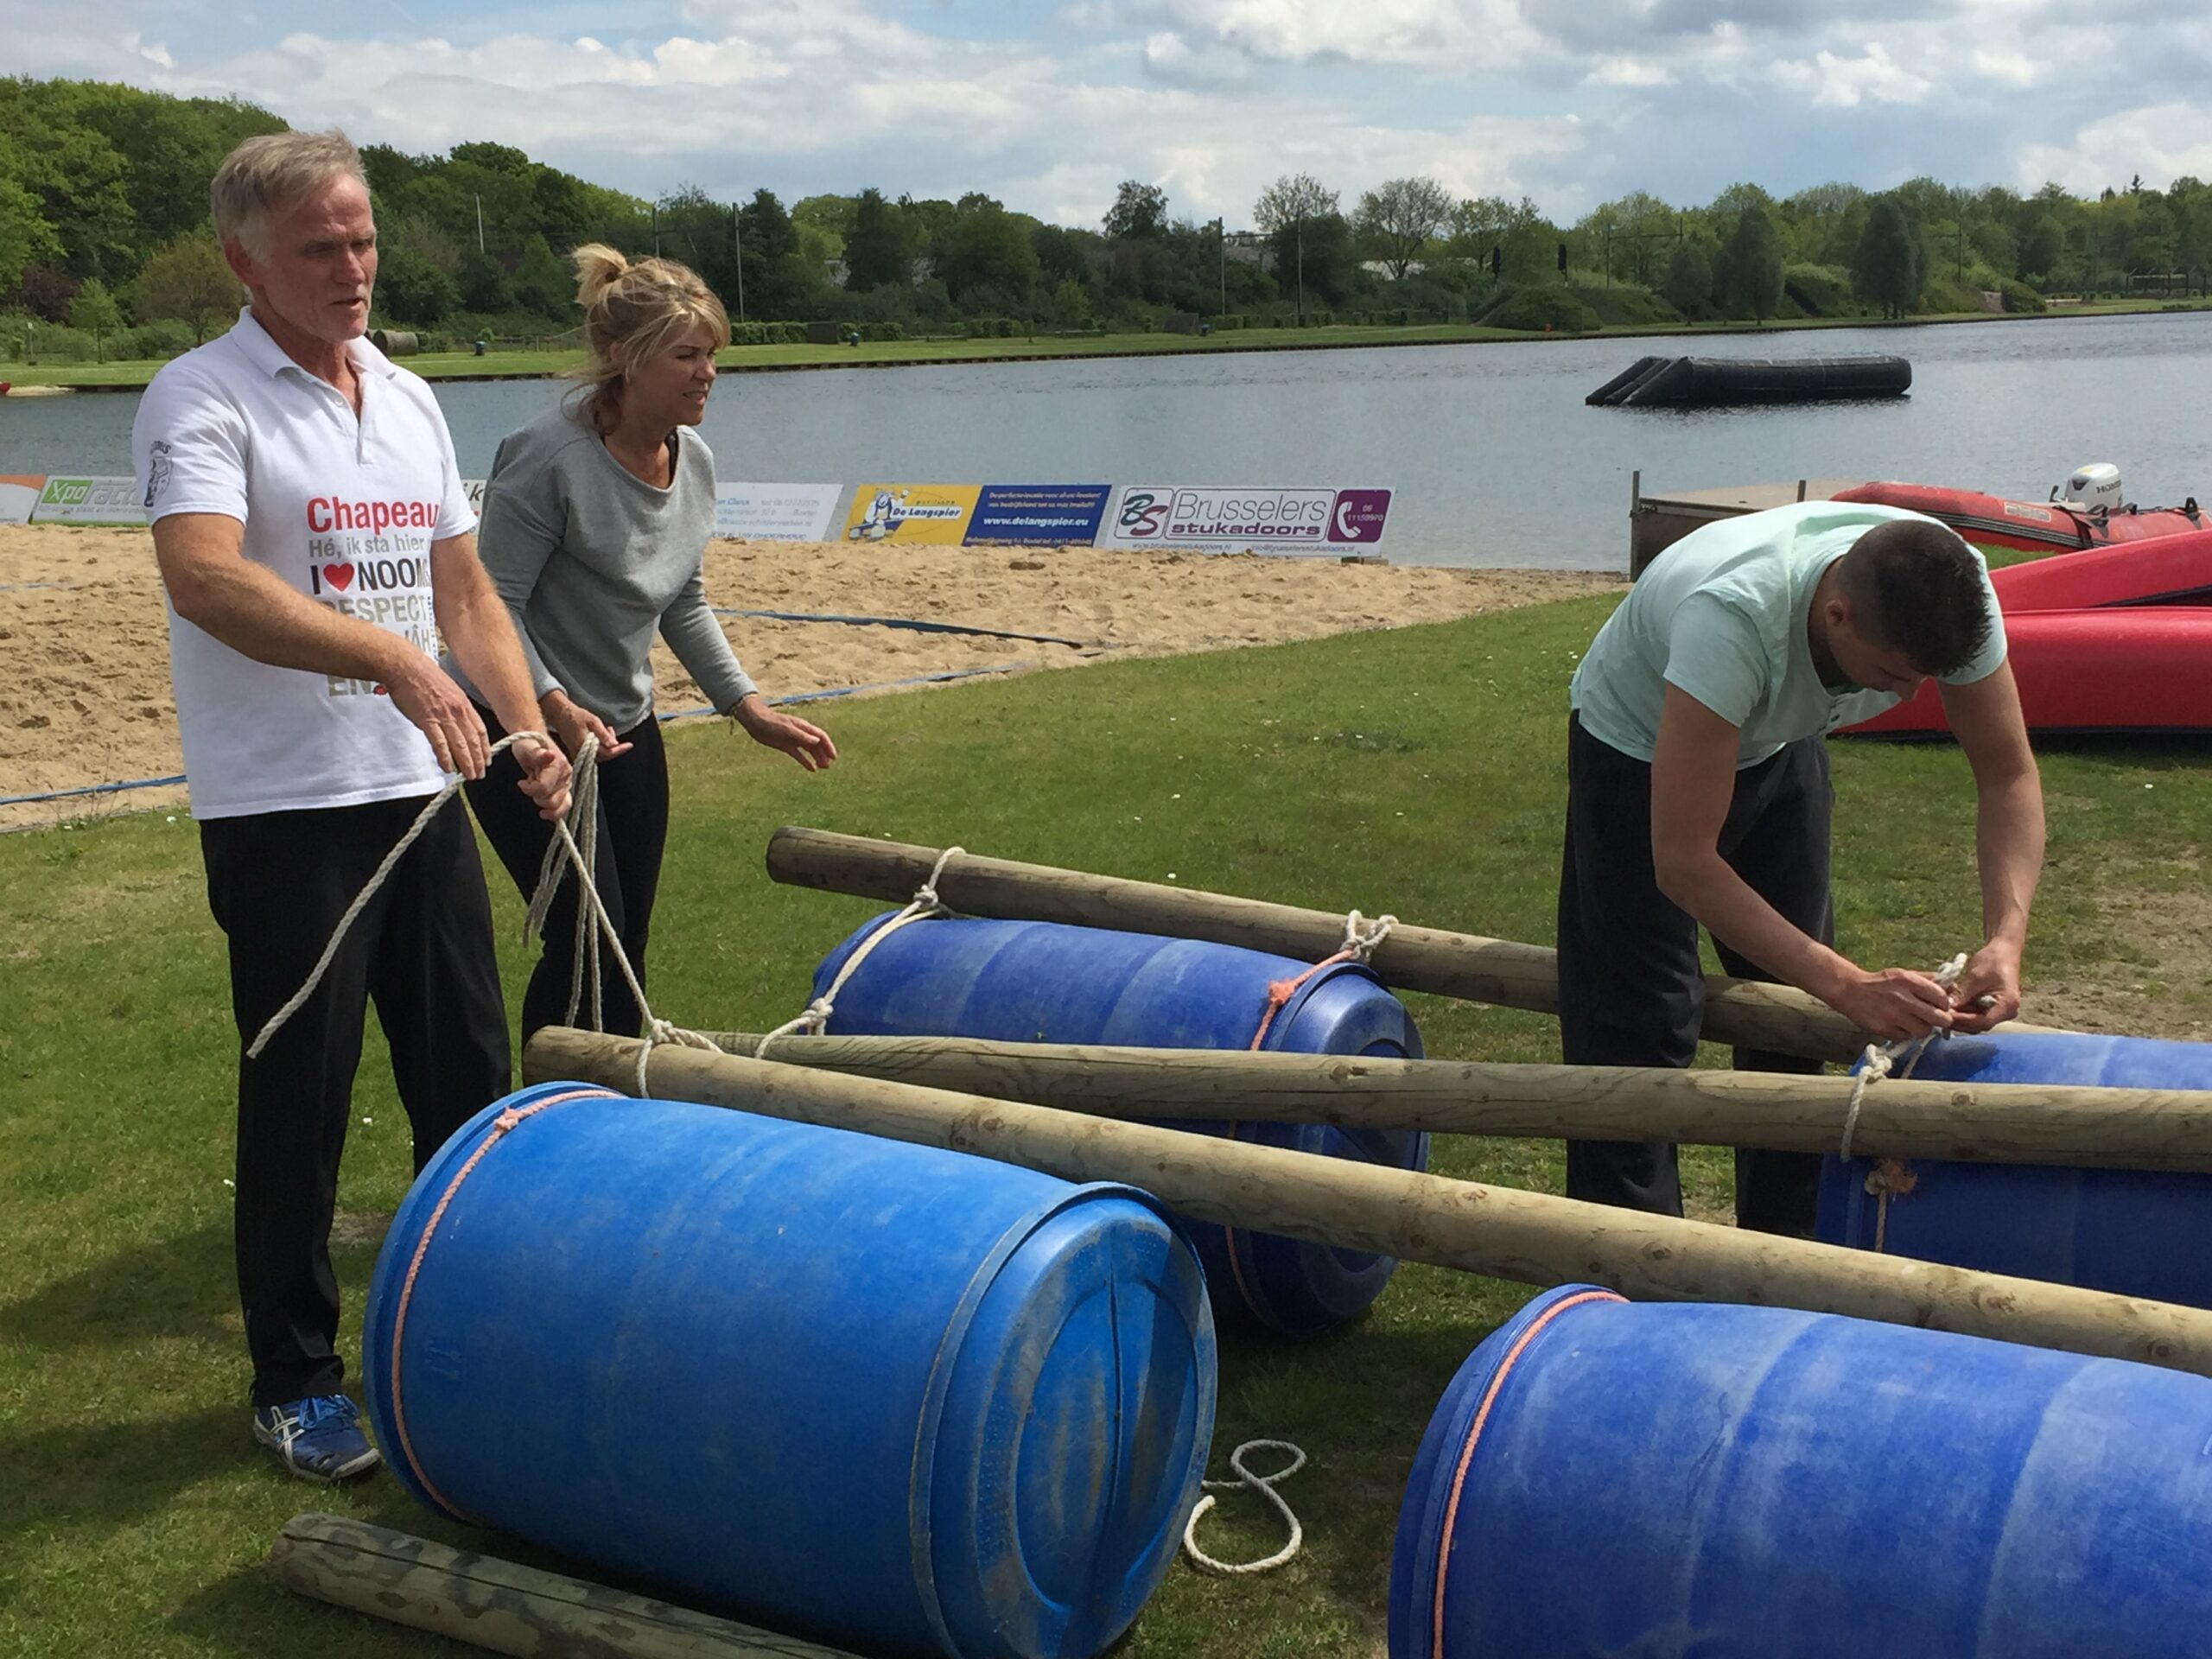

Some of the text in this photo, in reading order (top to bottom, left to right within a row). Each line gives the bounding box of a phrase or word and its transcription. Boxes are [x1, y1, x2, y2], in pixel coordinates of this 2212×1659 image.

[307, 496, 439, 536] Chapeau
[893, 507, 961, 518] De Langspier
[1174, 493, 1327, 521] Brusselers
[983, 517, 1089, 528] www.delangspier.eu
[1172, 521, 1320, 535] stukadoors
[308, 537, 341, 559] Hé,
[346, 537, 361, 555] ik
[365, 536, 389, 554] sta
[394, 534, 424, 551] hier
[310, 564, 321, 594] I
